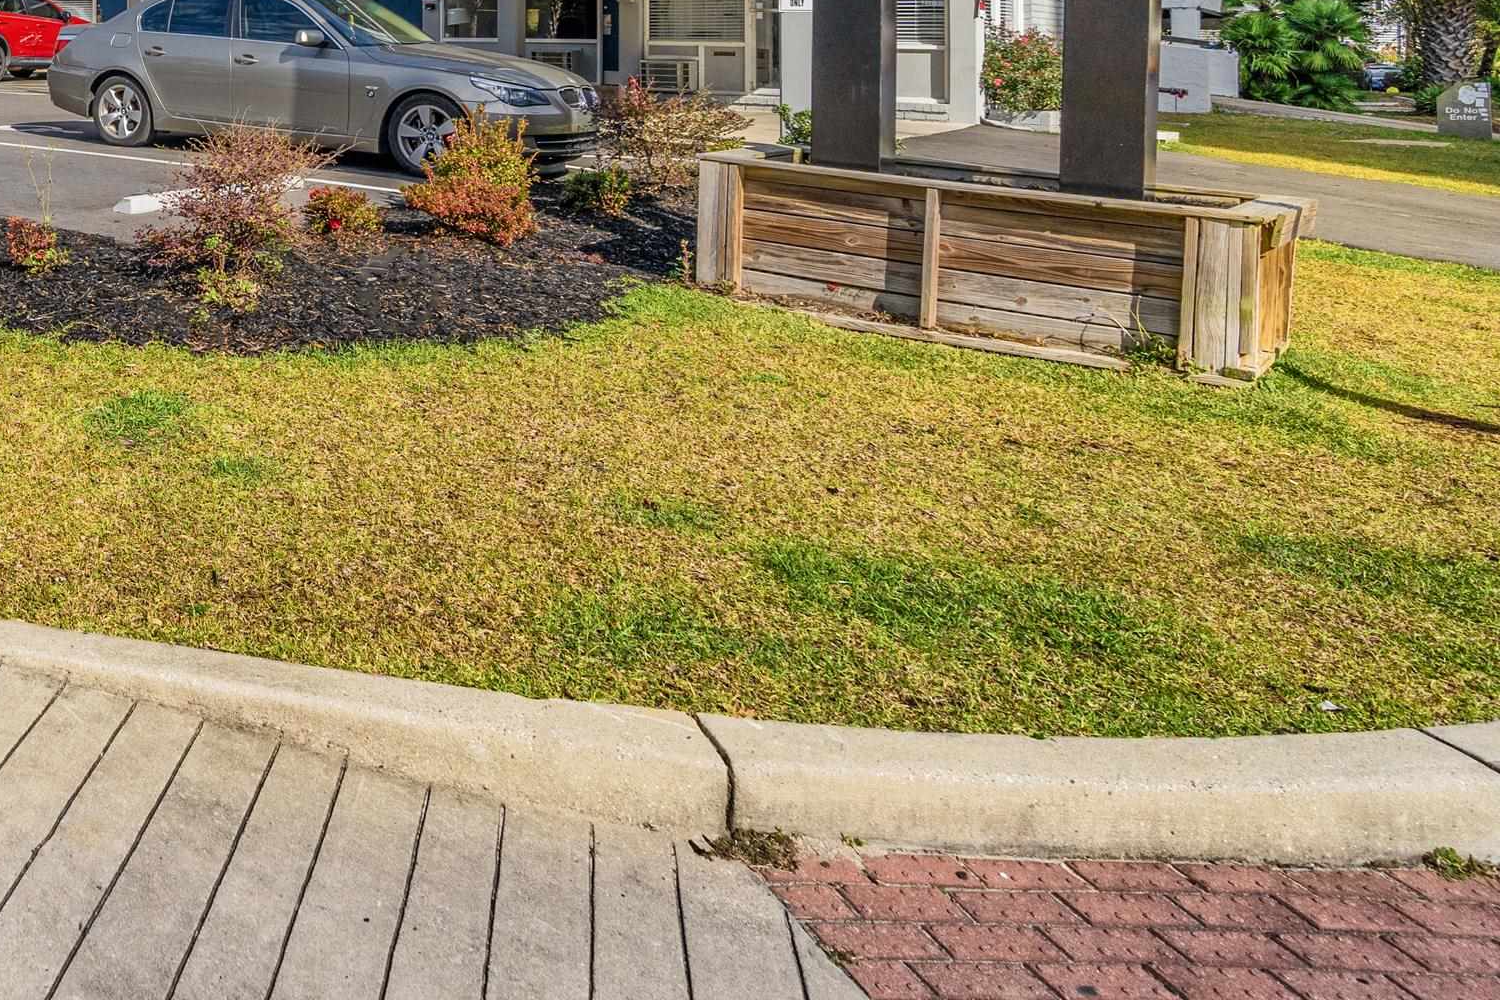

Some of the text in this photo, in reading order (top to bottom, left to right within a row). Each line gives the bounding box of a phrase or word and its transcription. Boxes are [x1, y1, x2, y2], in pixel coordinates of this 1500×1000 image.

[789, 0, 804, 7] ONLY
[1445, 106, 1460, 114] Do
[1450, 113, 1477, 121] Enter
